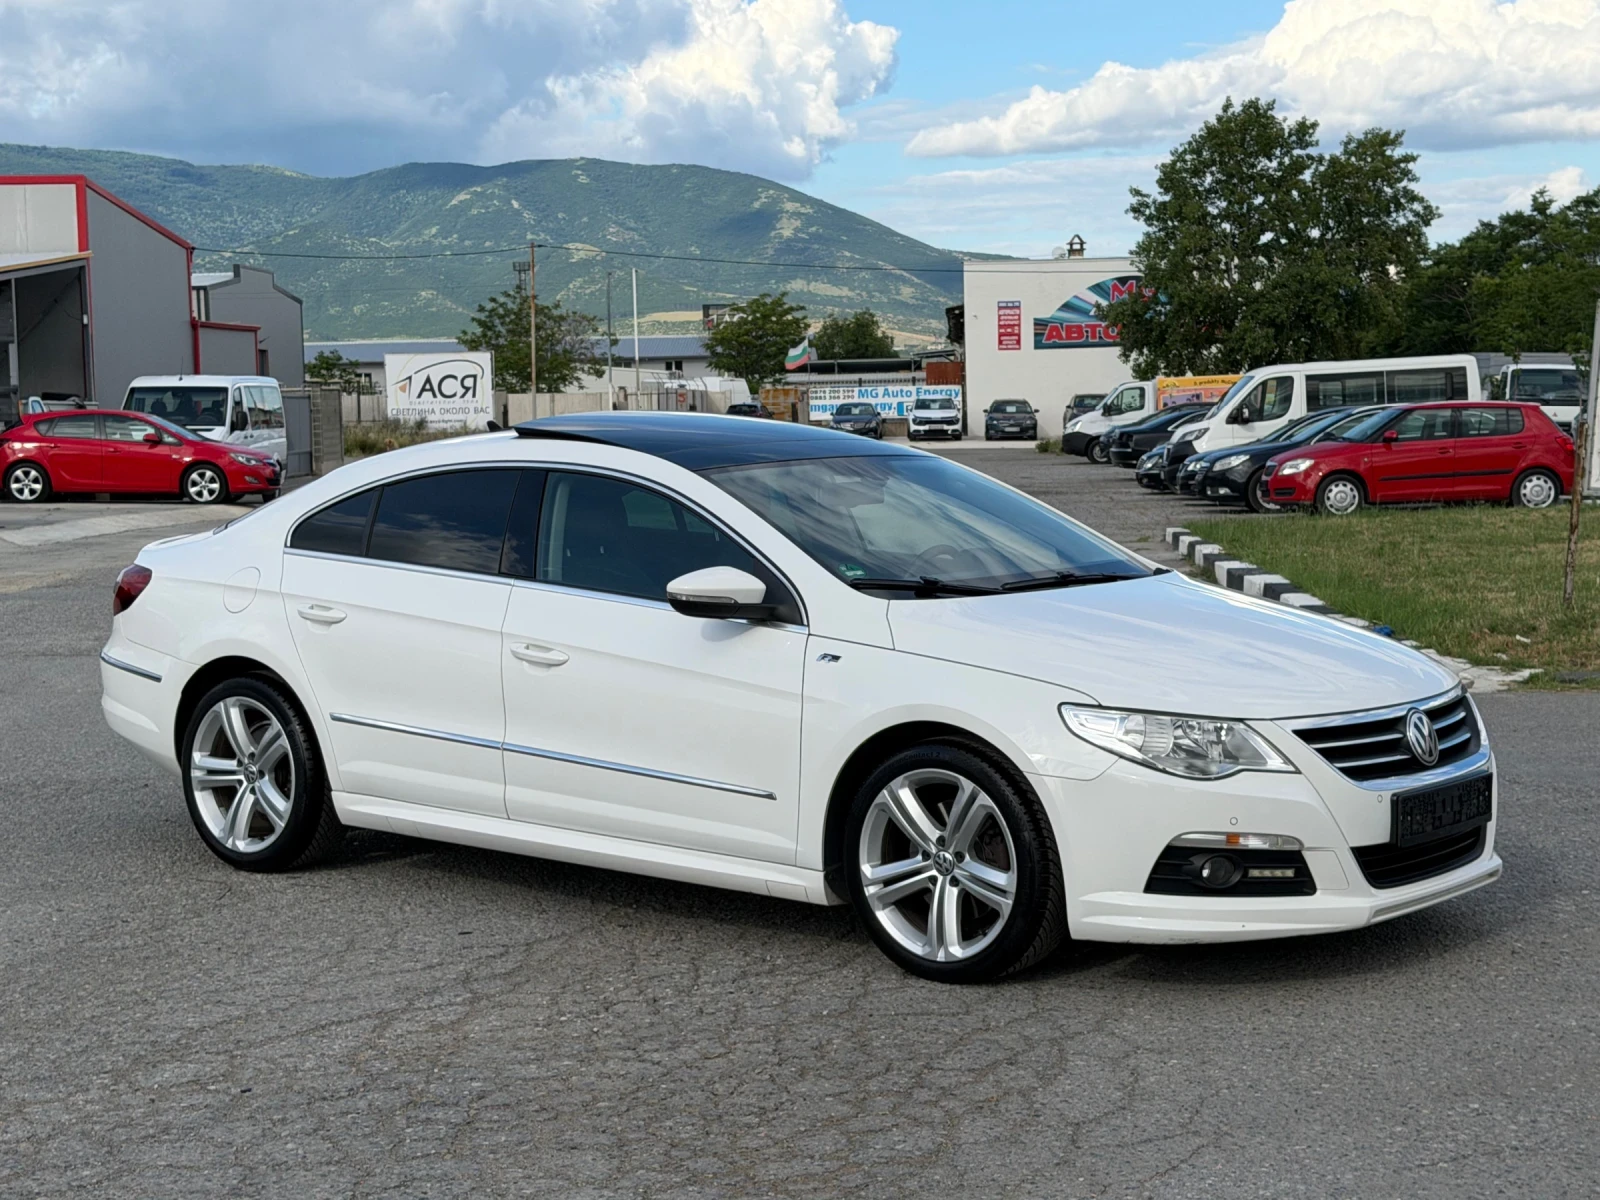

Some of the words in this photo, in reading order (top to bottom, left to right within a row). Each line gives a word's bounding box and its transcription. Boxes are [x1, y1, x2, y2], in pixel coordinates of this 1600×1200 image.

[416, 373, 478, 399] АСЯ
[857, 388, 879, 399] MG
[882, 388, 912, 398] Auto
[390, 407, 436, 417] СВЕТЛИНА
[439, 407, 470, 415] ОКОЛО
[473, 406, 490, 415] ВАС
